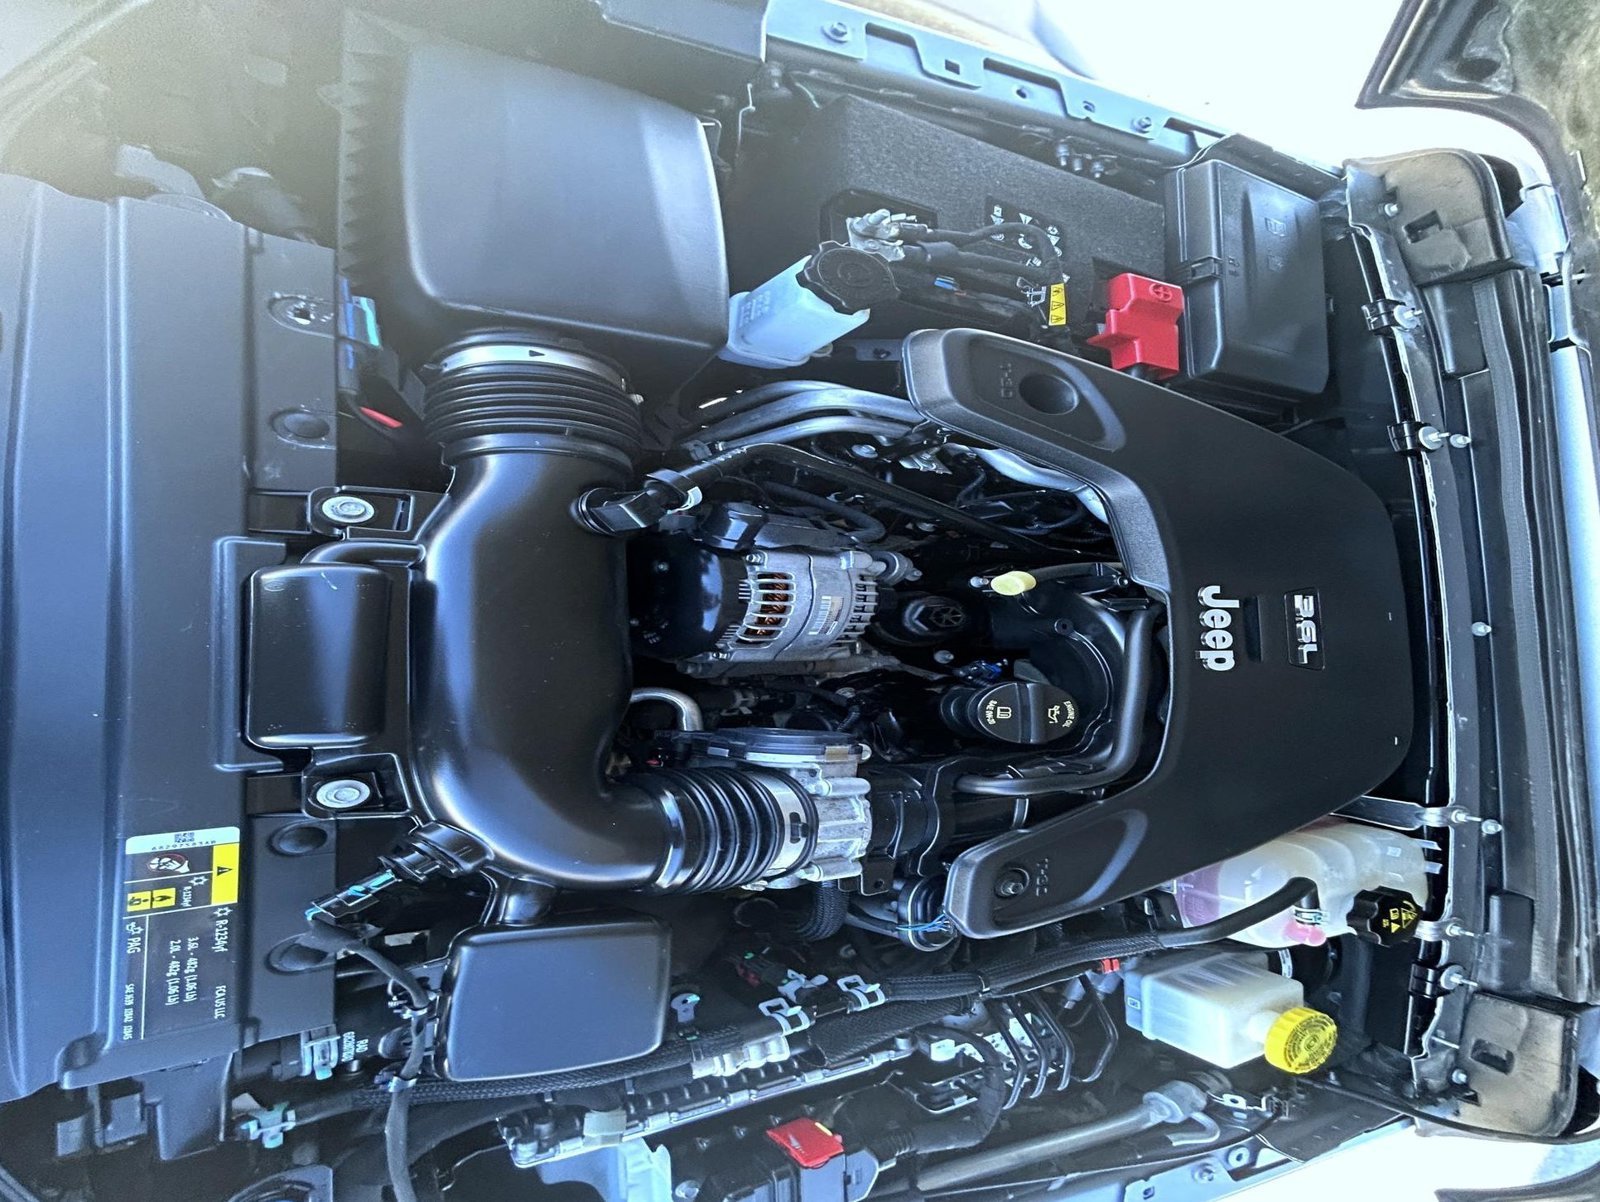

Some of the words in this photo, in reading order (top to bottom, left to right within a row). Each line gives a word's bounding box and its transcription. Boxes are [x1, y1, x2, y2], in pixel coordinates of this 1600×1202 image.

[1198, 585, 1240, 671] Jeep
[1294, 594, 1318, 664] 3.6L
[986, 700, 998, 710] SAE
[1063, 701, 1075, 720] ENGINE
[1062, 719, 1073, 728] OIL
[187, 936, 199, 951] 3.6L
[212, 919, 229, 952] R-1234yf
[127, 937, 141, 954] PAG
[170, 939, 181, 954] 2.0L
[166, 960, 180, 977] 482g
[184, 957, 198, 974] 482g
[166, 977, 180, 995] (1.06
[184, 974, 197, 992] (1.06
[215, 985, 226, 999] FCA
[214, 998, 226, 1008] US
[214, 1007, 226, 1020] LLC
[356, 1039, 369, 1053] RAD
